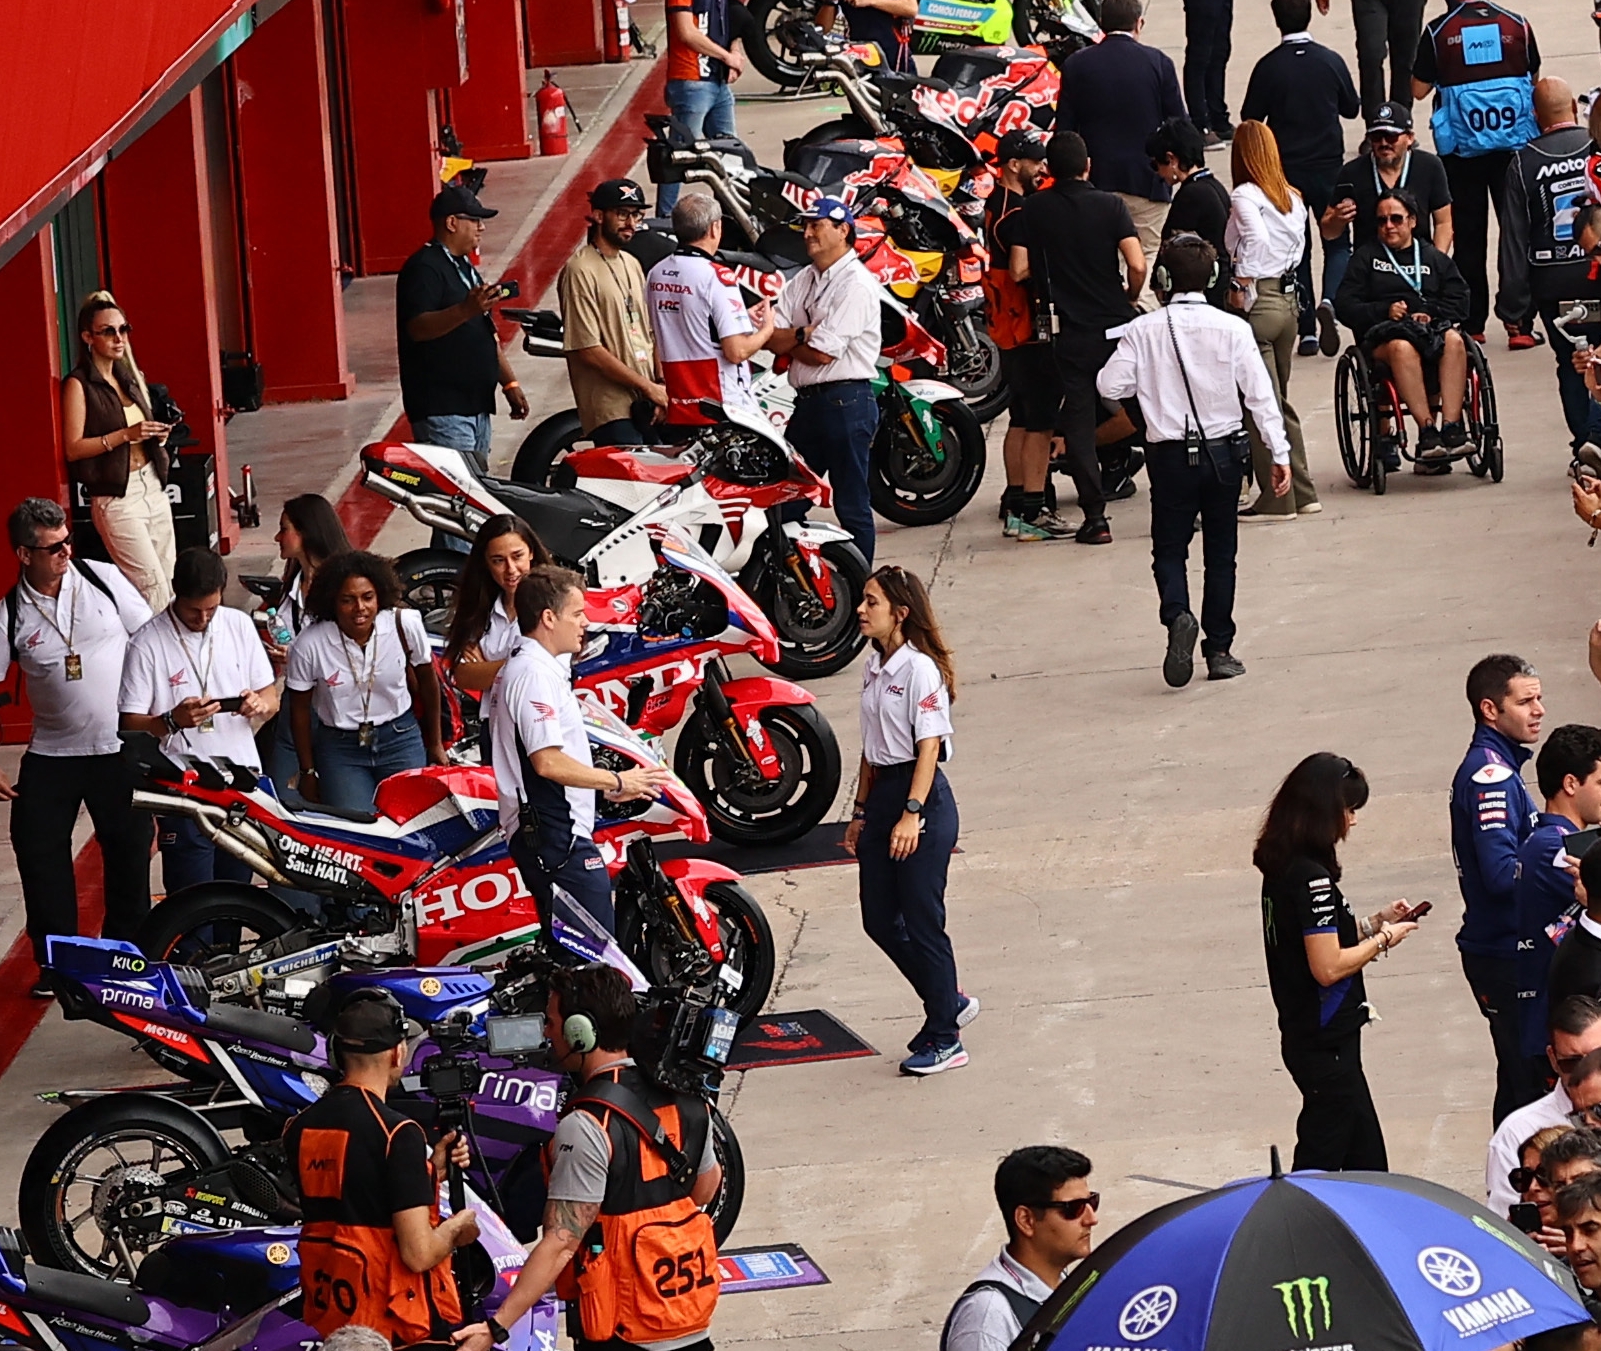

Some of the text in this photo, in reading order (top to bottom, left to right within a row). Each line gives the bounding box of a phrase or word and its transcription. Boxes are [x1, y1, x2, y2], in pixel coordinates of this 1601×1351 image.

[1468, 105, 1517, 133] 009
[1536, 158, 1585, 181] Moto
[1557, 179, 1585, 190] CONTRO
[649, 281, 694, 295] HONDA
[657, 299, 681, 312] HRC
[278, 834, 365, 872] One HEART.
[314, 863, 349, 886] HATI.
[112, 954, 146, 972] KILO
[278, 948, 339, 975] MICHELIN
[100, 987, 155, 1010] prima
[143, 1022, 189, 1045] MOTUL
[478, 1071, 557, 1111] rima
[653, 1246, 715, 1298] 251
[1442, 1287, 1532, 1334] YAMAHA
